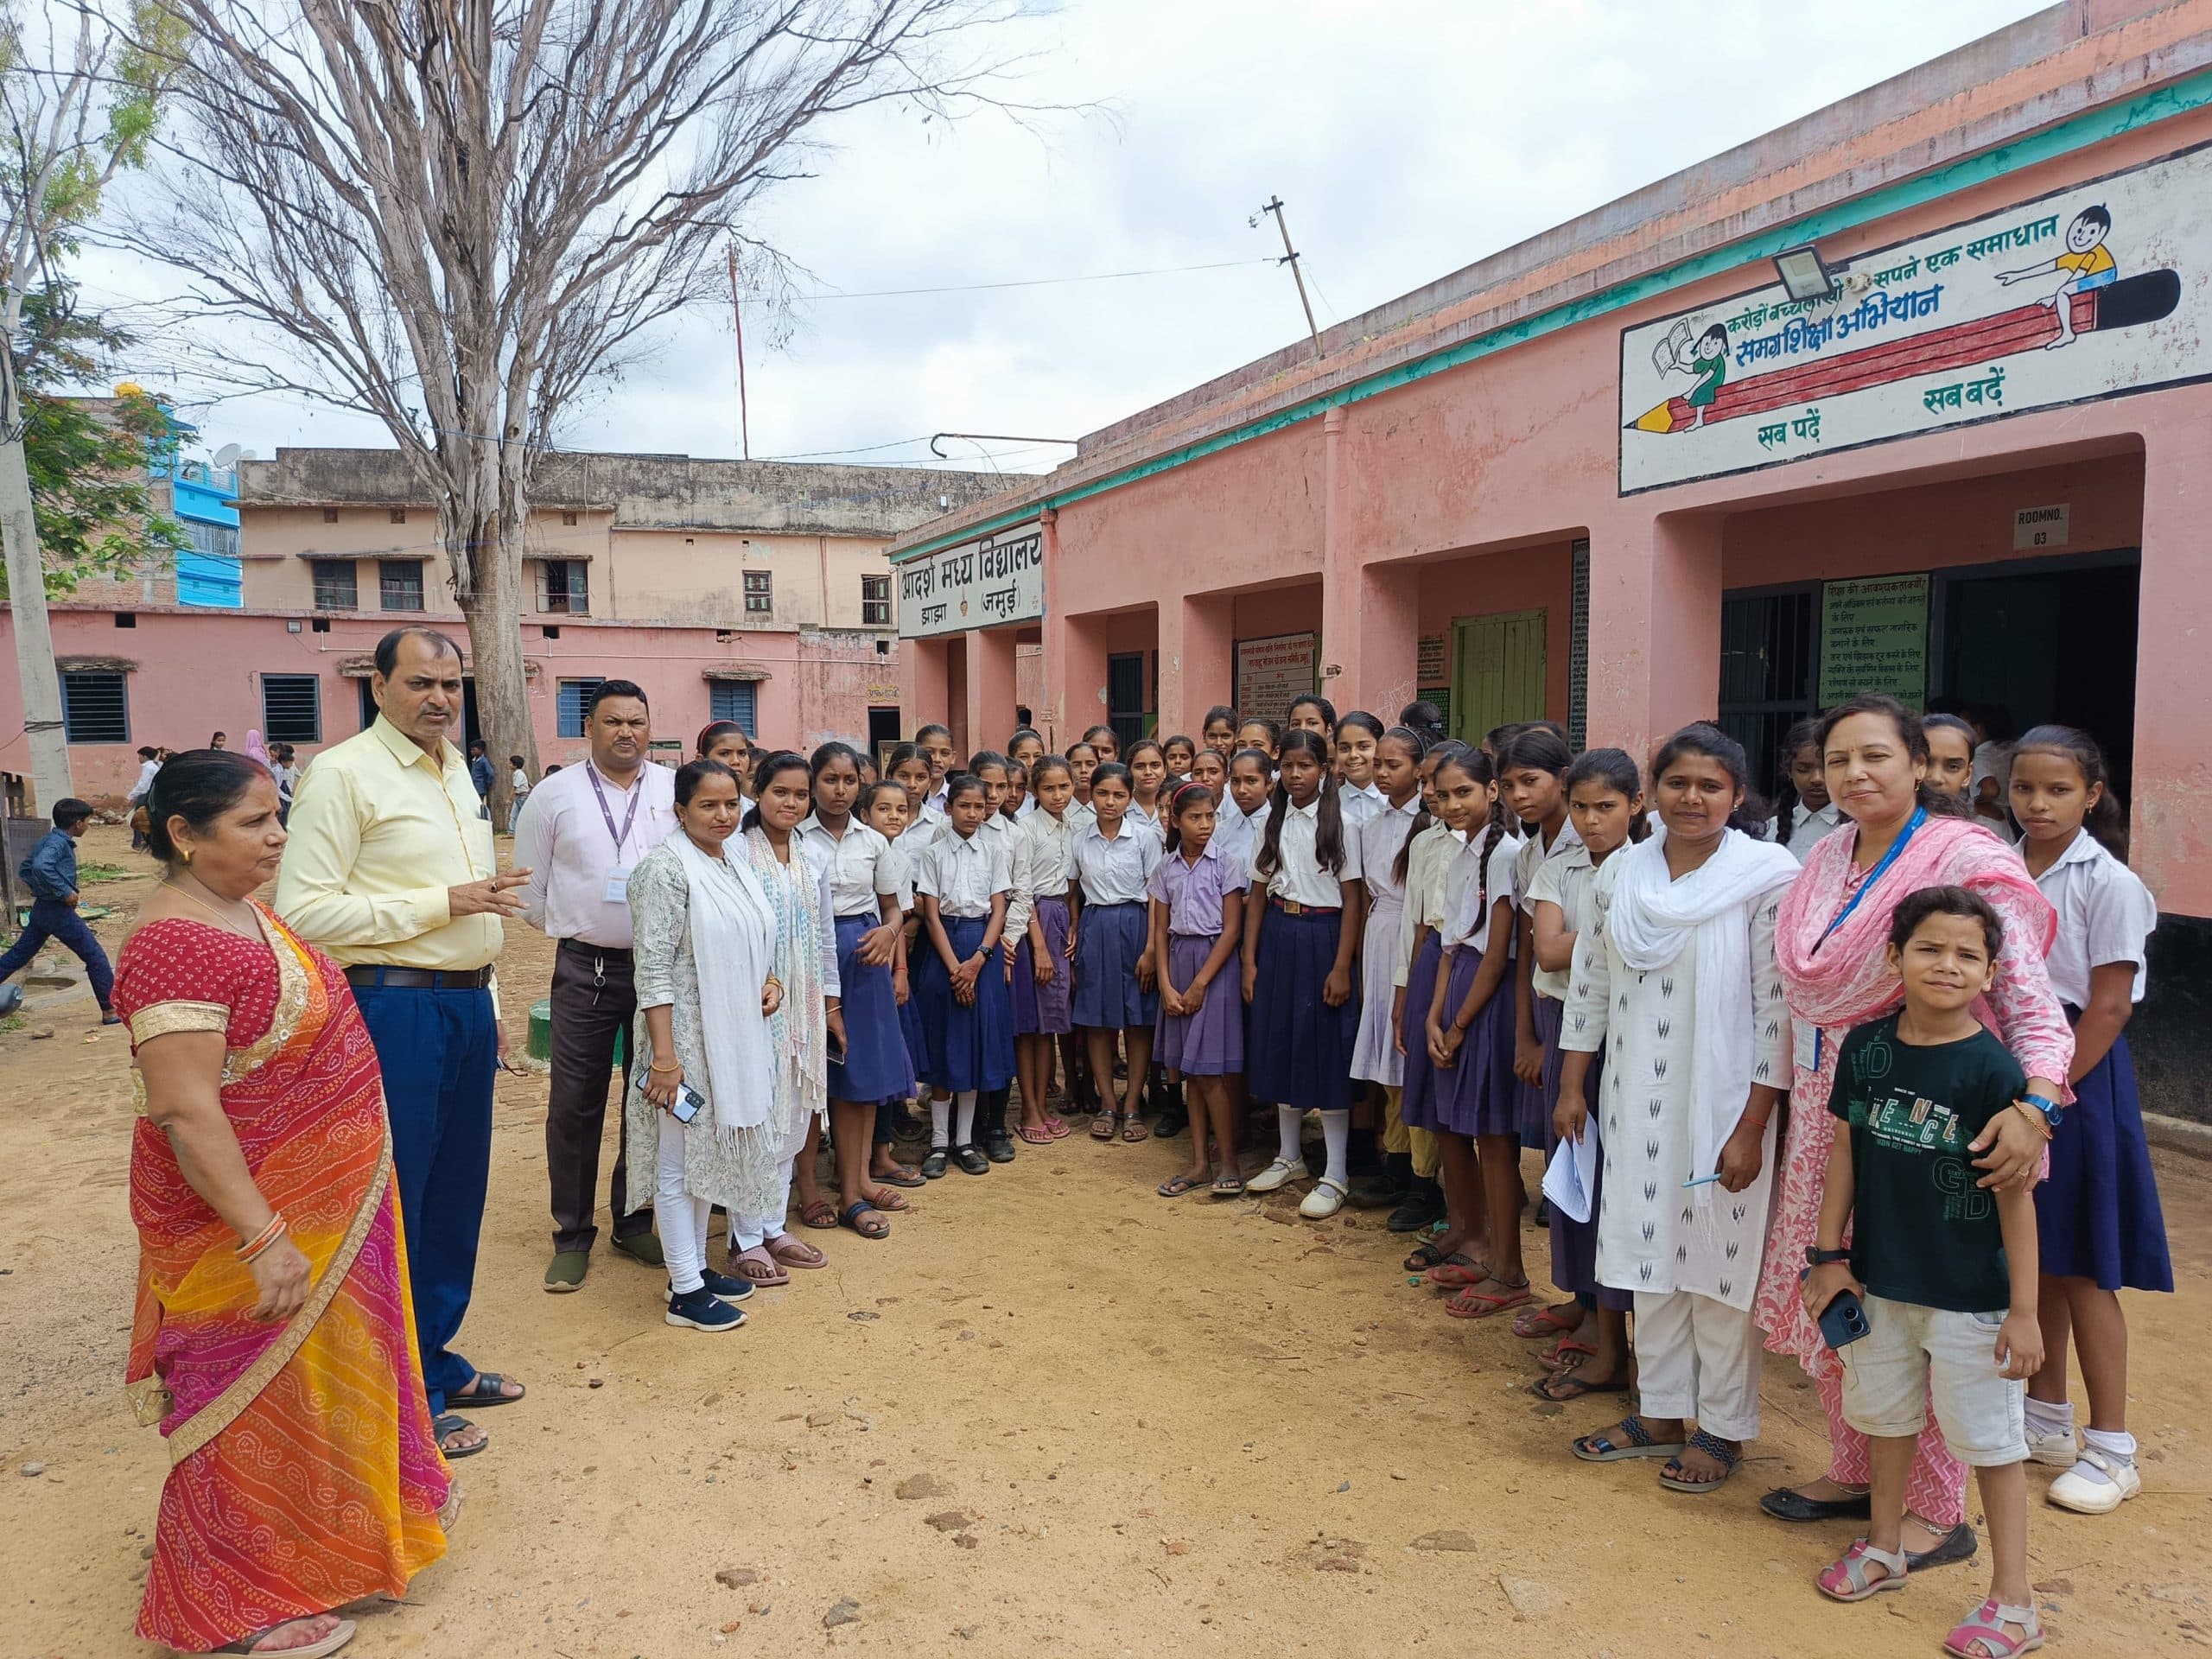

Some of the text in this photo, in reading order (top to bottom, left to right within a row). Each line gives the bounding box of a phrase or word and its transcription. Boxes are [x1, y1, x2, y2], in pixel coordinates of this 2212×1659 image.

[1873, 256, 1921, 288] सपने
[1925, 245, 1962, 273] एक
[1967, 214, 2060, 260] समाधान
[1735, 283, 1945, 367] समग्र शिक्षा अभियान
[1923, 366, 2005, 415] सब बढ़ें
[1758, 408, 1821, 451] सब पढ़ें
[2034, 532, 2047, 545] 03
[901, 532, 1042, 601] आदर्श मध्य विद्यालय
[1847, 582, 1859, 595] की
[921, 579, 1021, 626] झाझा (जमुई)
